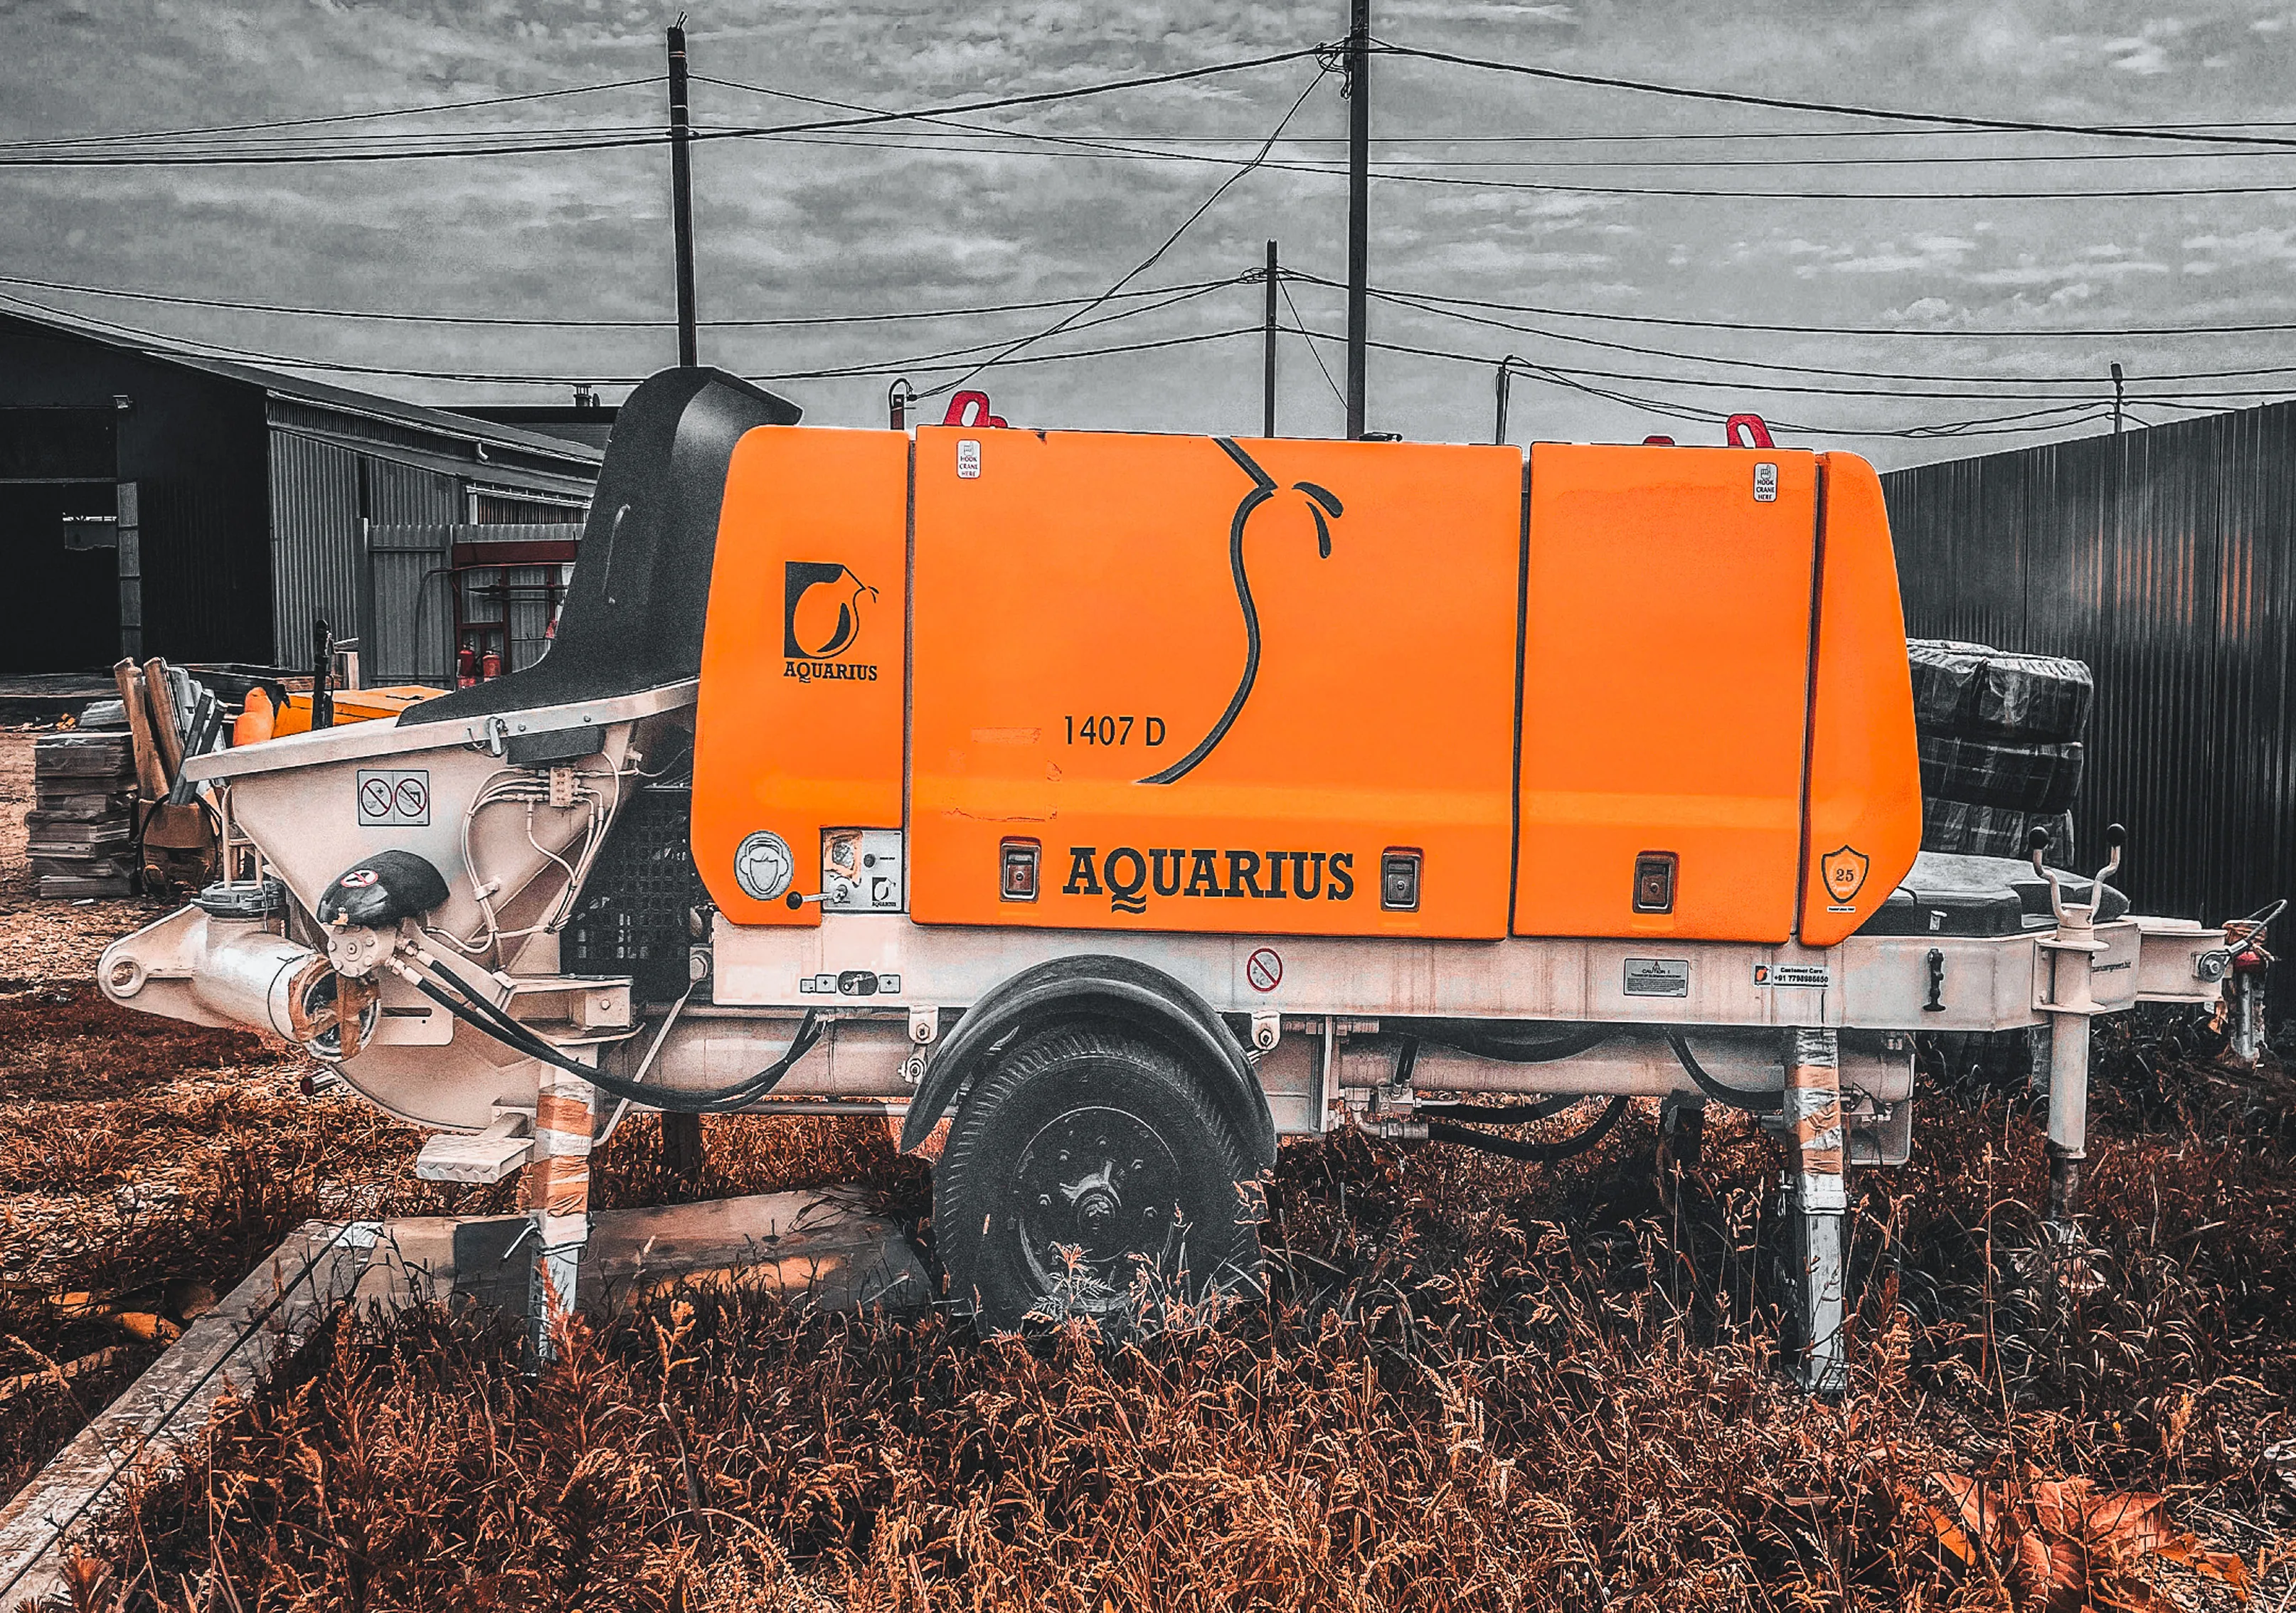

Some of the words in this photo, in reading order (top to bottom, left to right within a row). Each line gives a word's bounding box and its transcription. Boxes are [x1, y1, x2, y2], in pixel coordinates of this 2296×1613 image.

[783, 661, 878, 683] AQUARIUS
[1065, 715, 1134, 745] 1407
[1146, 717, 1166, 746] D
[1063, 847, 1354, 914] AQUARIUS
[1836, 868, 1854, 882] 25
